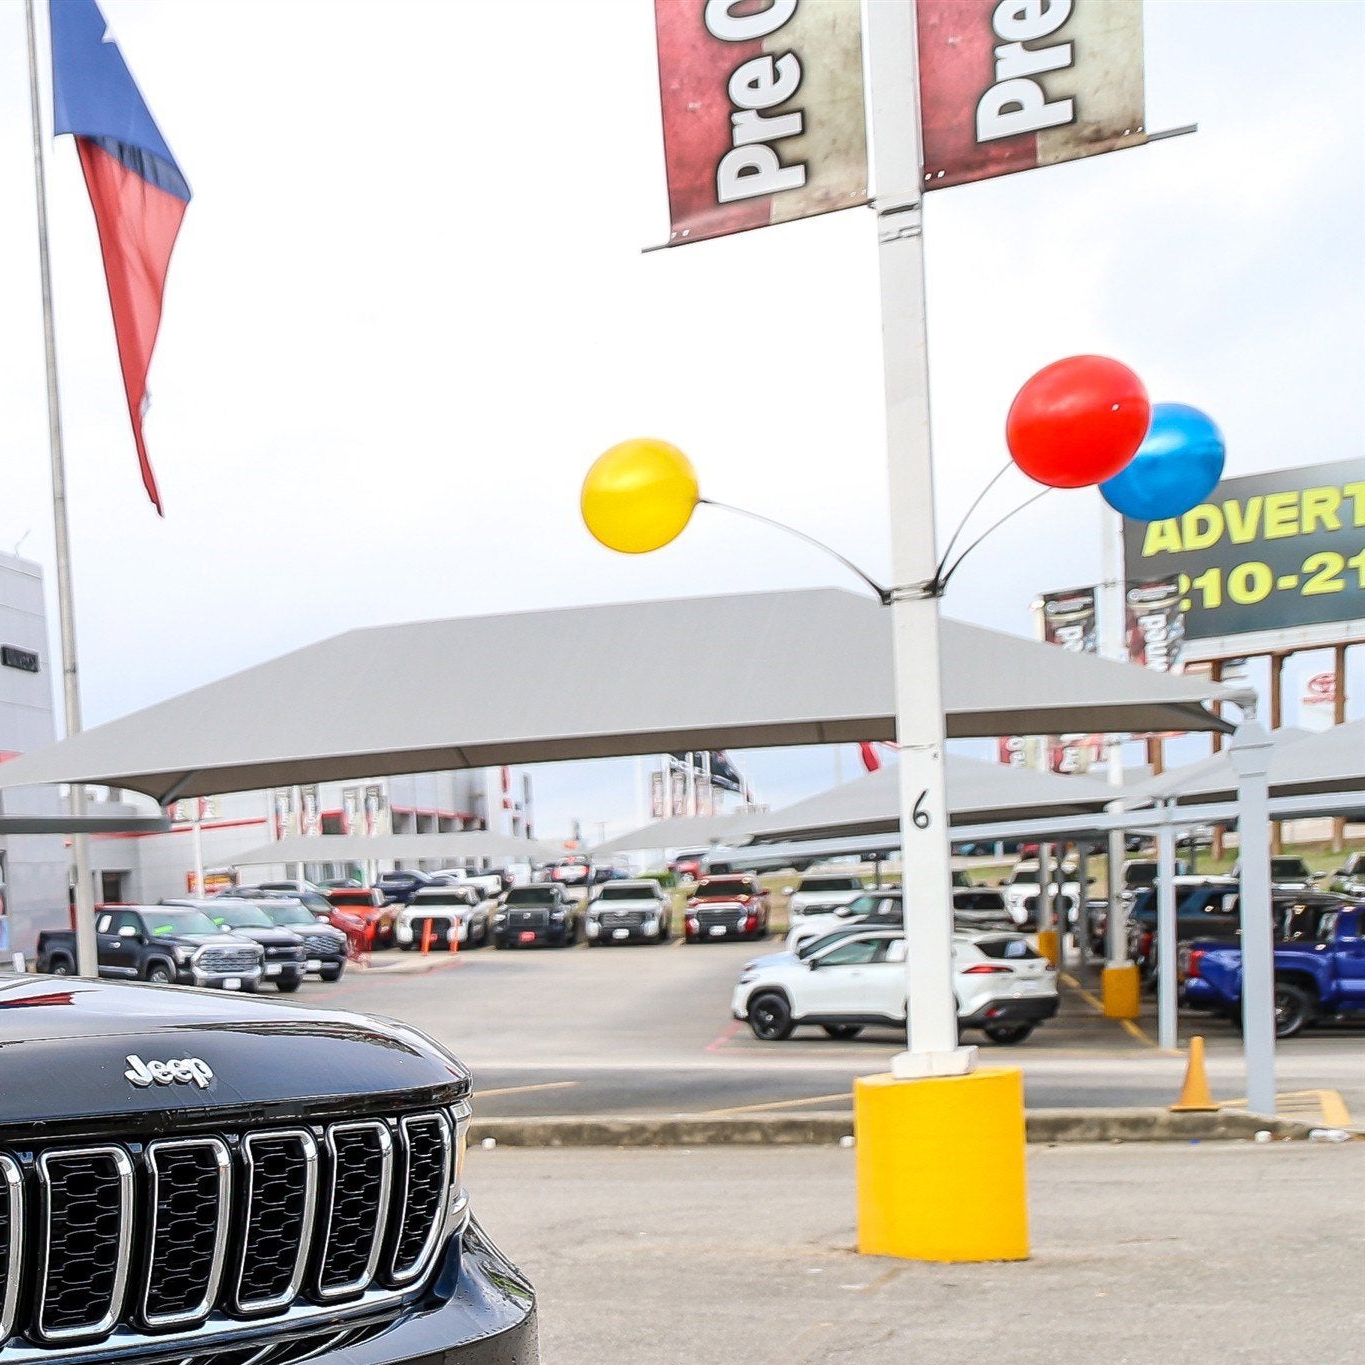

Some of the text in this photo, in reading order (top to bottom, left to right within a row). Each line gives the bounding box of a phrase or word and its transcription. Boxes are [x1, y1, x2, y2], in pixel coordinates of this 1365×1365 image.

[975, 0, 1077, 143] Pre
[716, 49, 807, 205] Pre
[1142, 481, 1365, 557] ADVERT
[1178, 548, 1365, 612] 10-21
[912, 790, 929, 829] 6
[124, 1054, 214, 1089] Jeep
